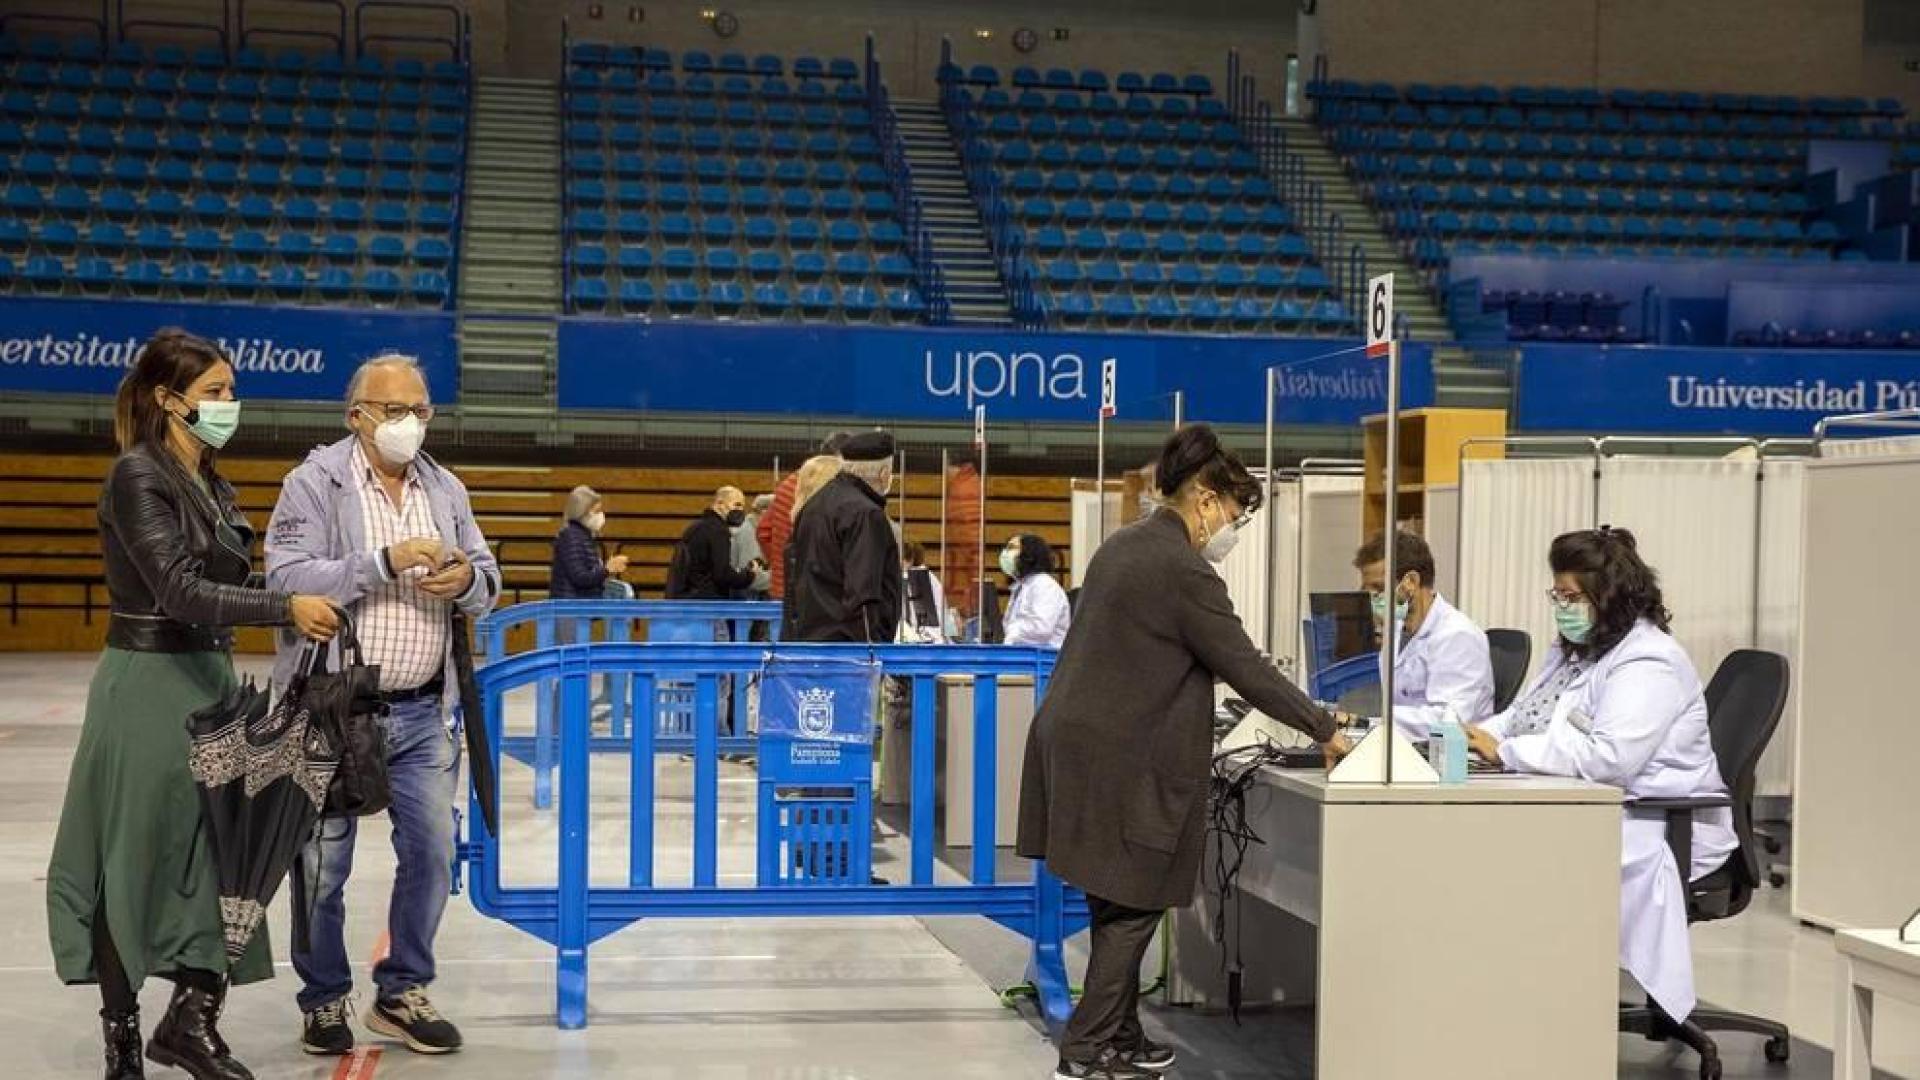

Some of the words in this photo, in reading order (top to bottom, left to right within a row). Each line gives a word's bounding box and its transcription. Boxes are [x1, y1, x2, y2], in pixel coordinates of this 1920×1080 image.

[1373, 282, 1386, 339] 6
[0, 332, 148, 368] ertsitat
[925, 350, 1087, 411] upna
[1104, 364, 1112, 405] 5
[1668, 375, 1865, 411] Universidad
[1876, 380, 1920, 410] Pú
